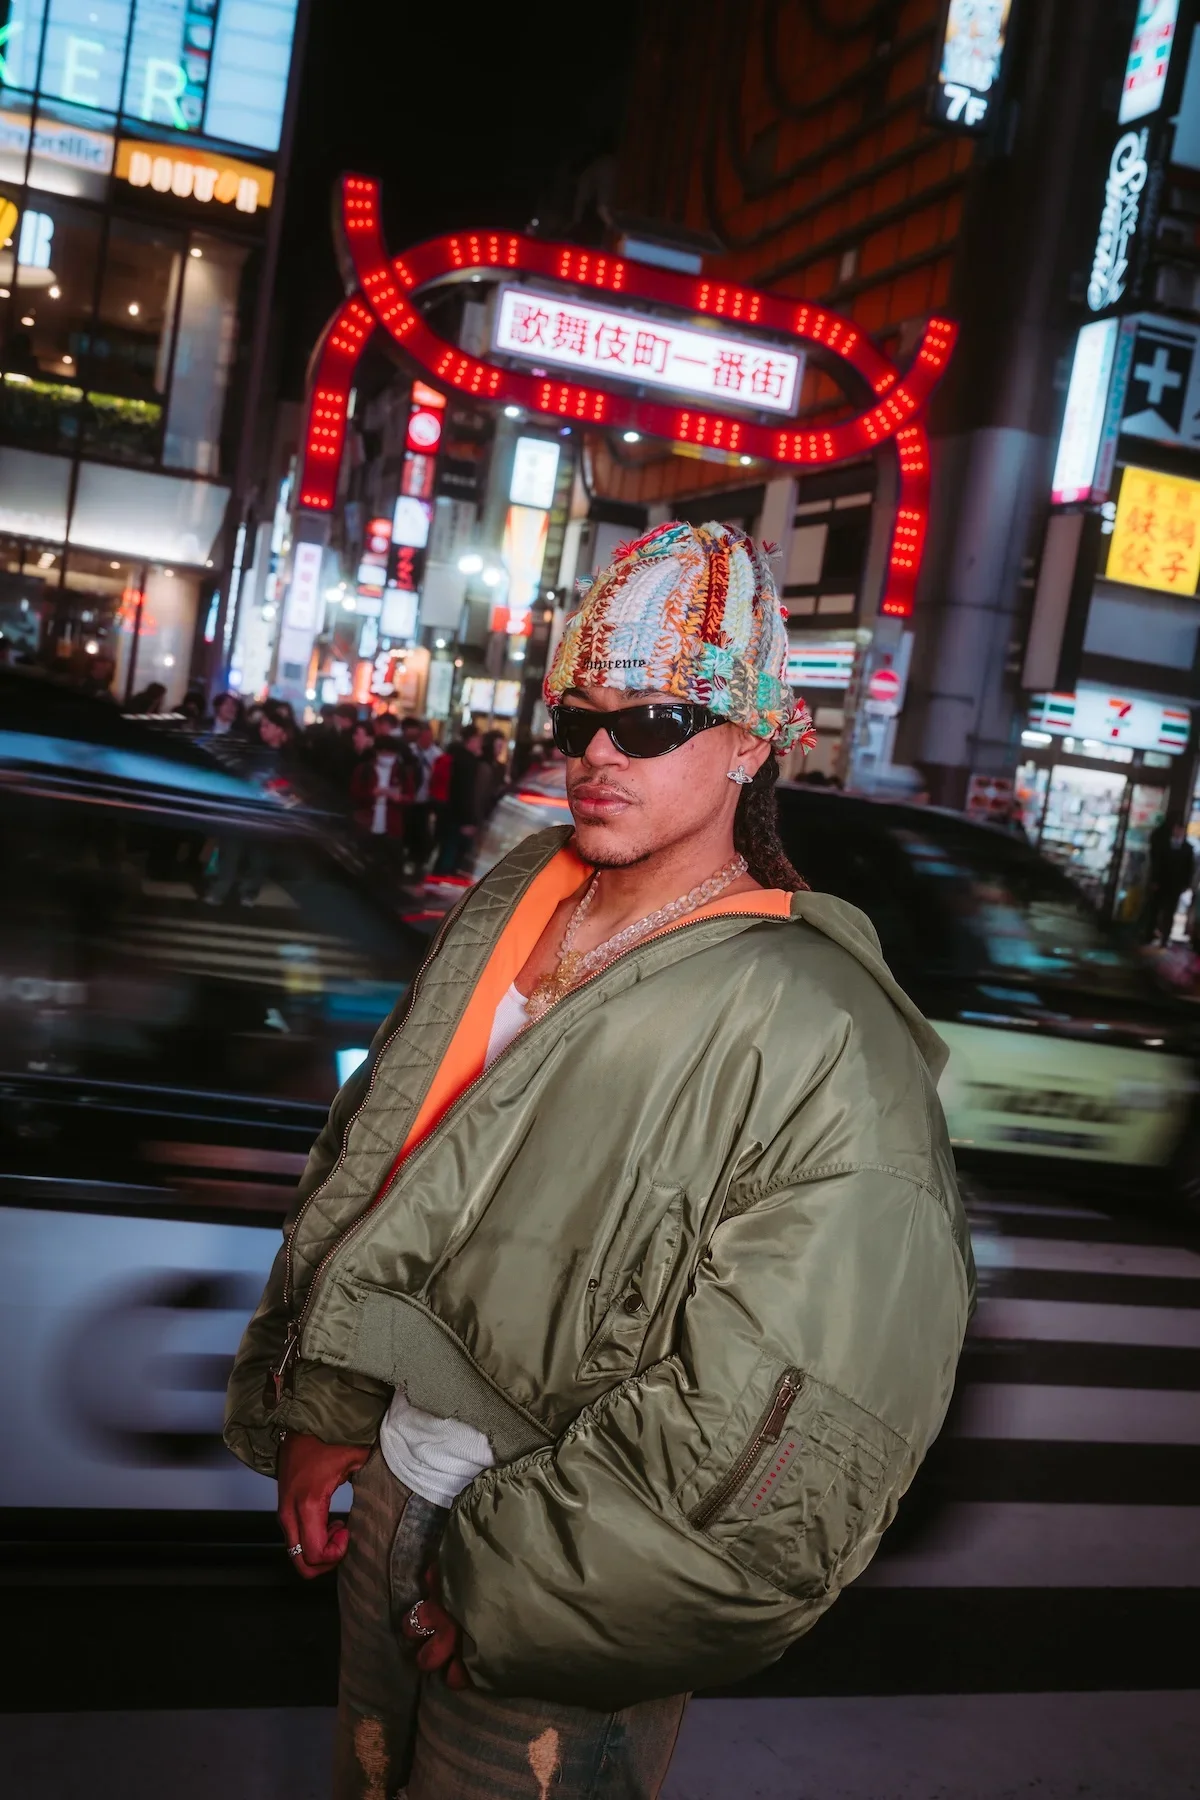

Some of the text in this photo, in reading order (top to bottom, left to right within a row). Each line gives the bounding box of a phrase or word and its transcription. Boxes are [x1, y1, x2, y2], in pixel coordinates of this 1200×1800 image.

[943, 82, 988, 127] 7F
[510, 302, 789, 400] 歌舞伎町一番街
[751, 1441, 796, 1509] RASPBERRY
